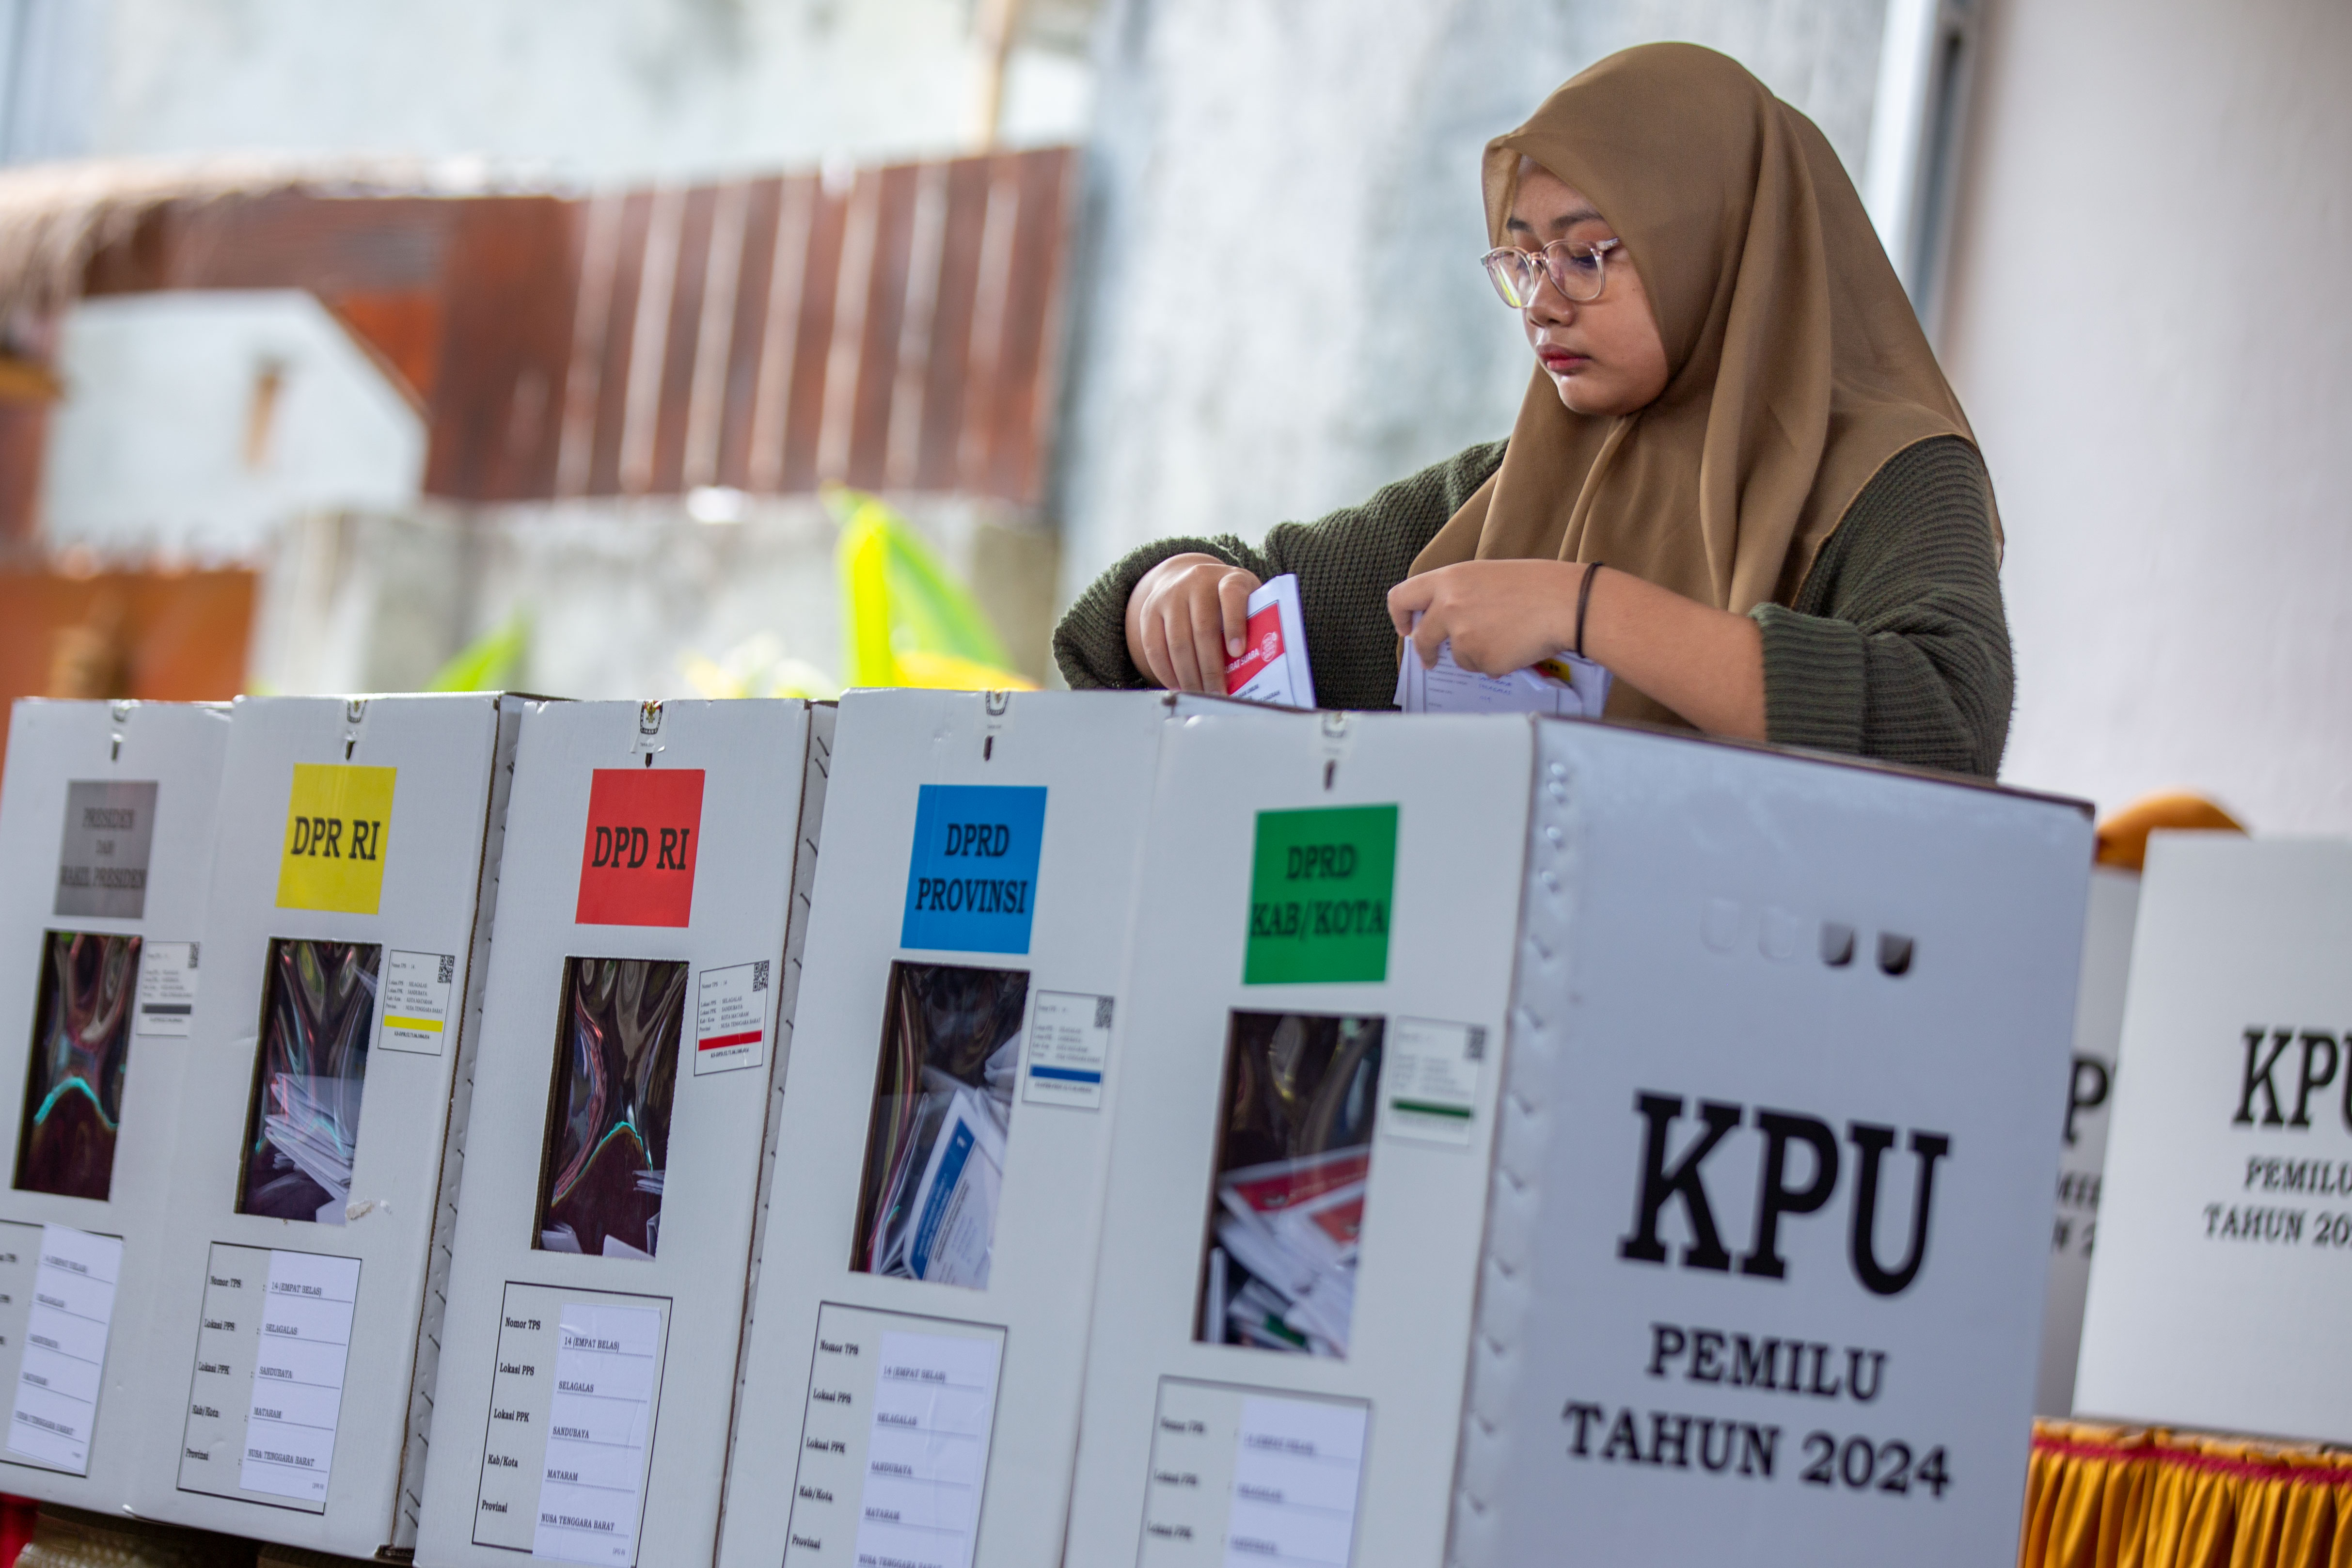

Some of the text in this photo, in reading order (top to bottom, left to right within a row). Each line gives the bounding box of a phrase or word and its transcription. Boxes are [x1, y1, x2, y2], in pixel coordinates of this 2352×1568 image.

[1241, 648, 1260, 665] SUARA
[291, 816, 380, 860] DPR RI
[592, 826, 690, 870] DPD RI
[944, 823, 1010, 857] DPRD
[1286, 843, 1358, 880] DPRD
[915, 877, 1028, 914] PROVINSI
[1249, 899, 1388, 943] KAB/KOTA
[722, 995, 742, 1004] SELAGALAS
[722, 1004, 742, 1012] SANDUBAYA
[749, 1017, 761, 1025] BARAT
[2232, 1025, 2352, 1138] KP
[1616, 1088, 1954, 1299] KPU
[2203, 1204, 2305, 1244] TAHUN
[210, 1276, 322, 1298] Nomor TPS 14 (EMPAT BELAS)
[204, 1318, 298, 1335] Lokasi PPS SELAGALAS
[505, 1317, 619, 1354] Nomor TPS 14 (EMPAT BELAS)
[198, 1361, 292, 1379] Lokasi PPK SANDUBAYA
[820, 1339, 843, 1353] Nomor
[845, 1343, 859, 1355] TPS
[884, 1365, 891, 1375] 14
[893, 1366, 920, 1379] (EMPAT
[1646, 1320, 1890, 1405] PEMILU
[500, 1362, 594, 1393] Lokasi PPS SELAGALAS
[192, 1405, 283, 1419] Kab/Kota MATARAM
[813, 1388, 836, 1402] Lokasi
[877, 1412, 917, 1426] SELAGALAS
[493, 1408, 589, 1439] Lokasi PPK SANDUBAYA
[186, 1448, 315, 1467] Provinsi NUSA TENGGARA BARAT
[806, 1437, 829, 1450] Lokasi
[831, 1441, 846, 1453] PPK
[1561, 1398, 1954, 1502] TAHUN 2024
[488, 1454, 578, 1481] Kab/Kota MATARAM
[799, 1485, 833, 1502] Kab/Kota
[481, 1500, 615, 1531] Provinsi NUSA TENGGARA BARAT
[791, 1534, 821, 1550] Provinsi
